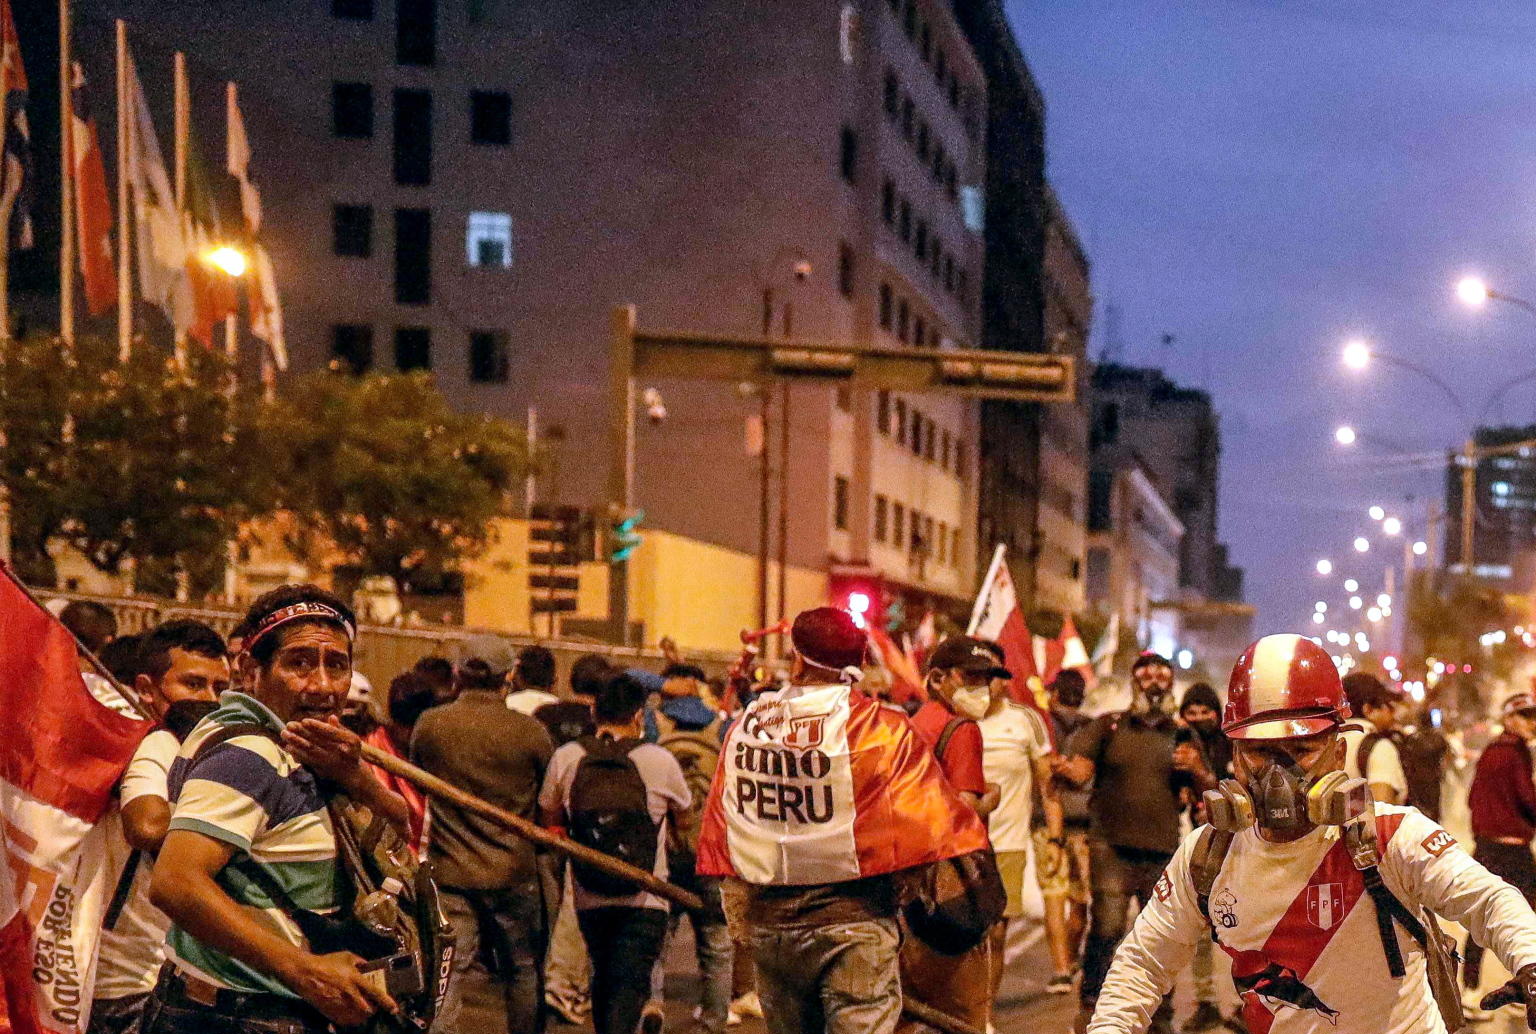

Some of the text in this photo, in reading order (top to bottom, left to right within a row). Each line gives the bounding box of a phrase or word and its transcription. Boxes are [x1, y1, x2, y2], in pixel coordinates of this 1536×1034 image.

[735, 742, 831, 779] amo
[736, 776, 834, 823] PERU
[1270, 807, 1290, 818] 3M
[1310, 899, 1340, 910] FPF
